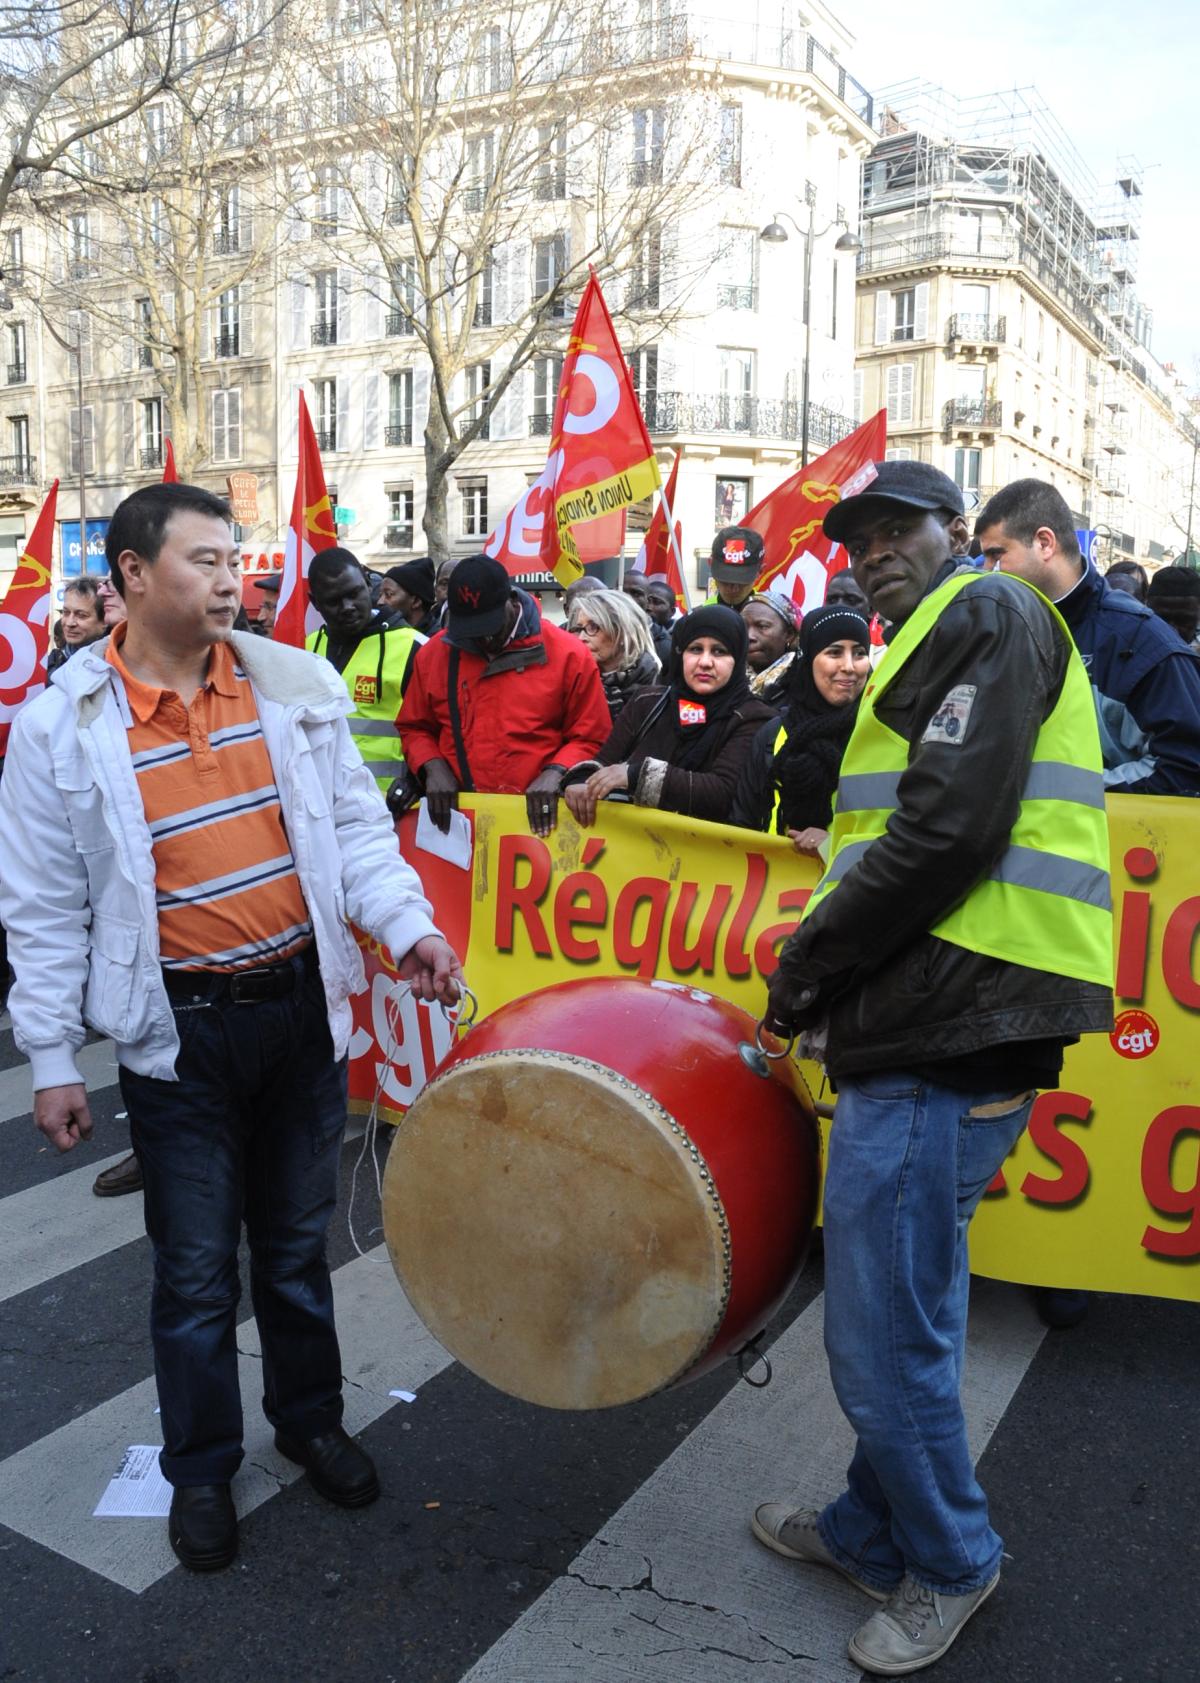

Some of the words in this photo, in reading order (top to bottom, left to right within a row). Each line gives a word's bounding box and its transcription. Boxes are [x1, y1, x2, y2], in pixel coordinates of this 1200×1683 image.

[725, 550, 744, 564] cgt
[515, 571, 558, 583] mine
[356, 682, 376, 696] cgt
[680, 708, 706, 723] cgt
[1118, 1028, 1154, 1053] cgt
